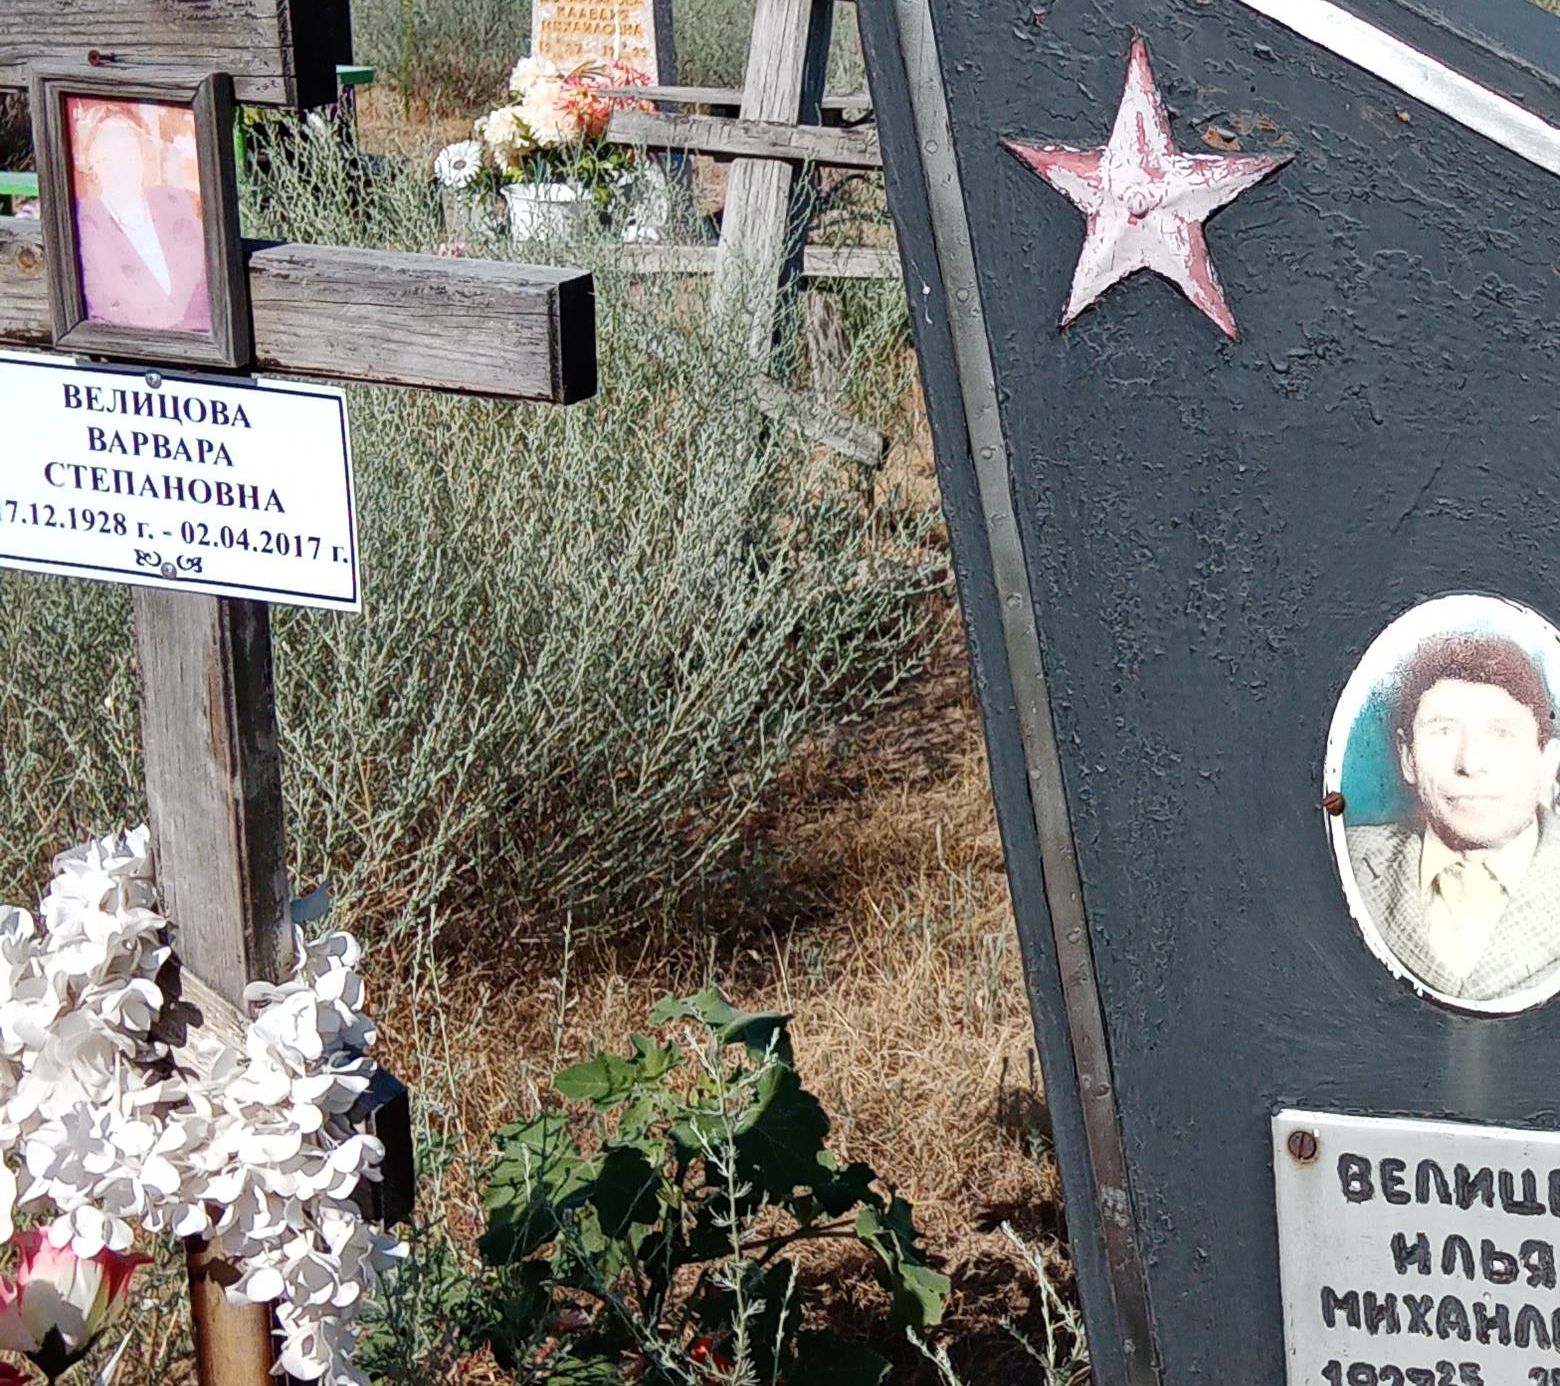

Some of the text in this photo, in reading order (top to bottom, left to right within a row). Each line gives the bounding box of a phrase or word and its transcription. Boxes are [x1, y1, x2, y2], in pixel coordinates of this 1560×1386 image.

[62, 382, 252, 429] ВЕЛИЦОВА
[87, 426, 235, 467] ВАРВАРА
[44, 461, 286, 514] СТЕПАНОВНА
[0, 499, 127, 536] 7.12.1928
[137, 521, 154, 539] г.
[181, 520, 322, 561] 02.04.2017
[331, 542, 349, 564] г.
[1391, 1231, 1557, 1290] ИЛЬЯ
